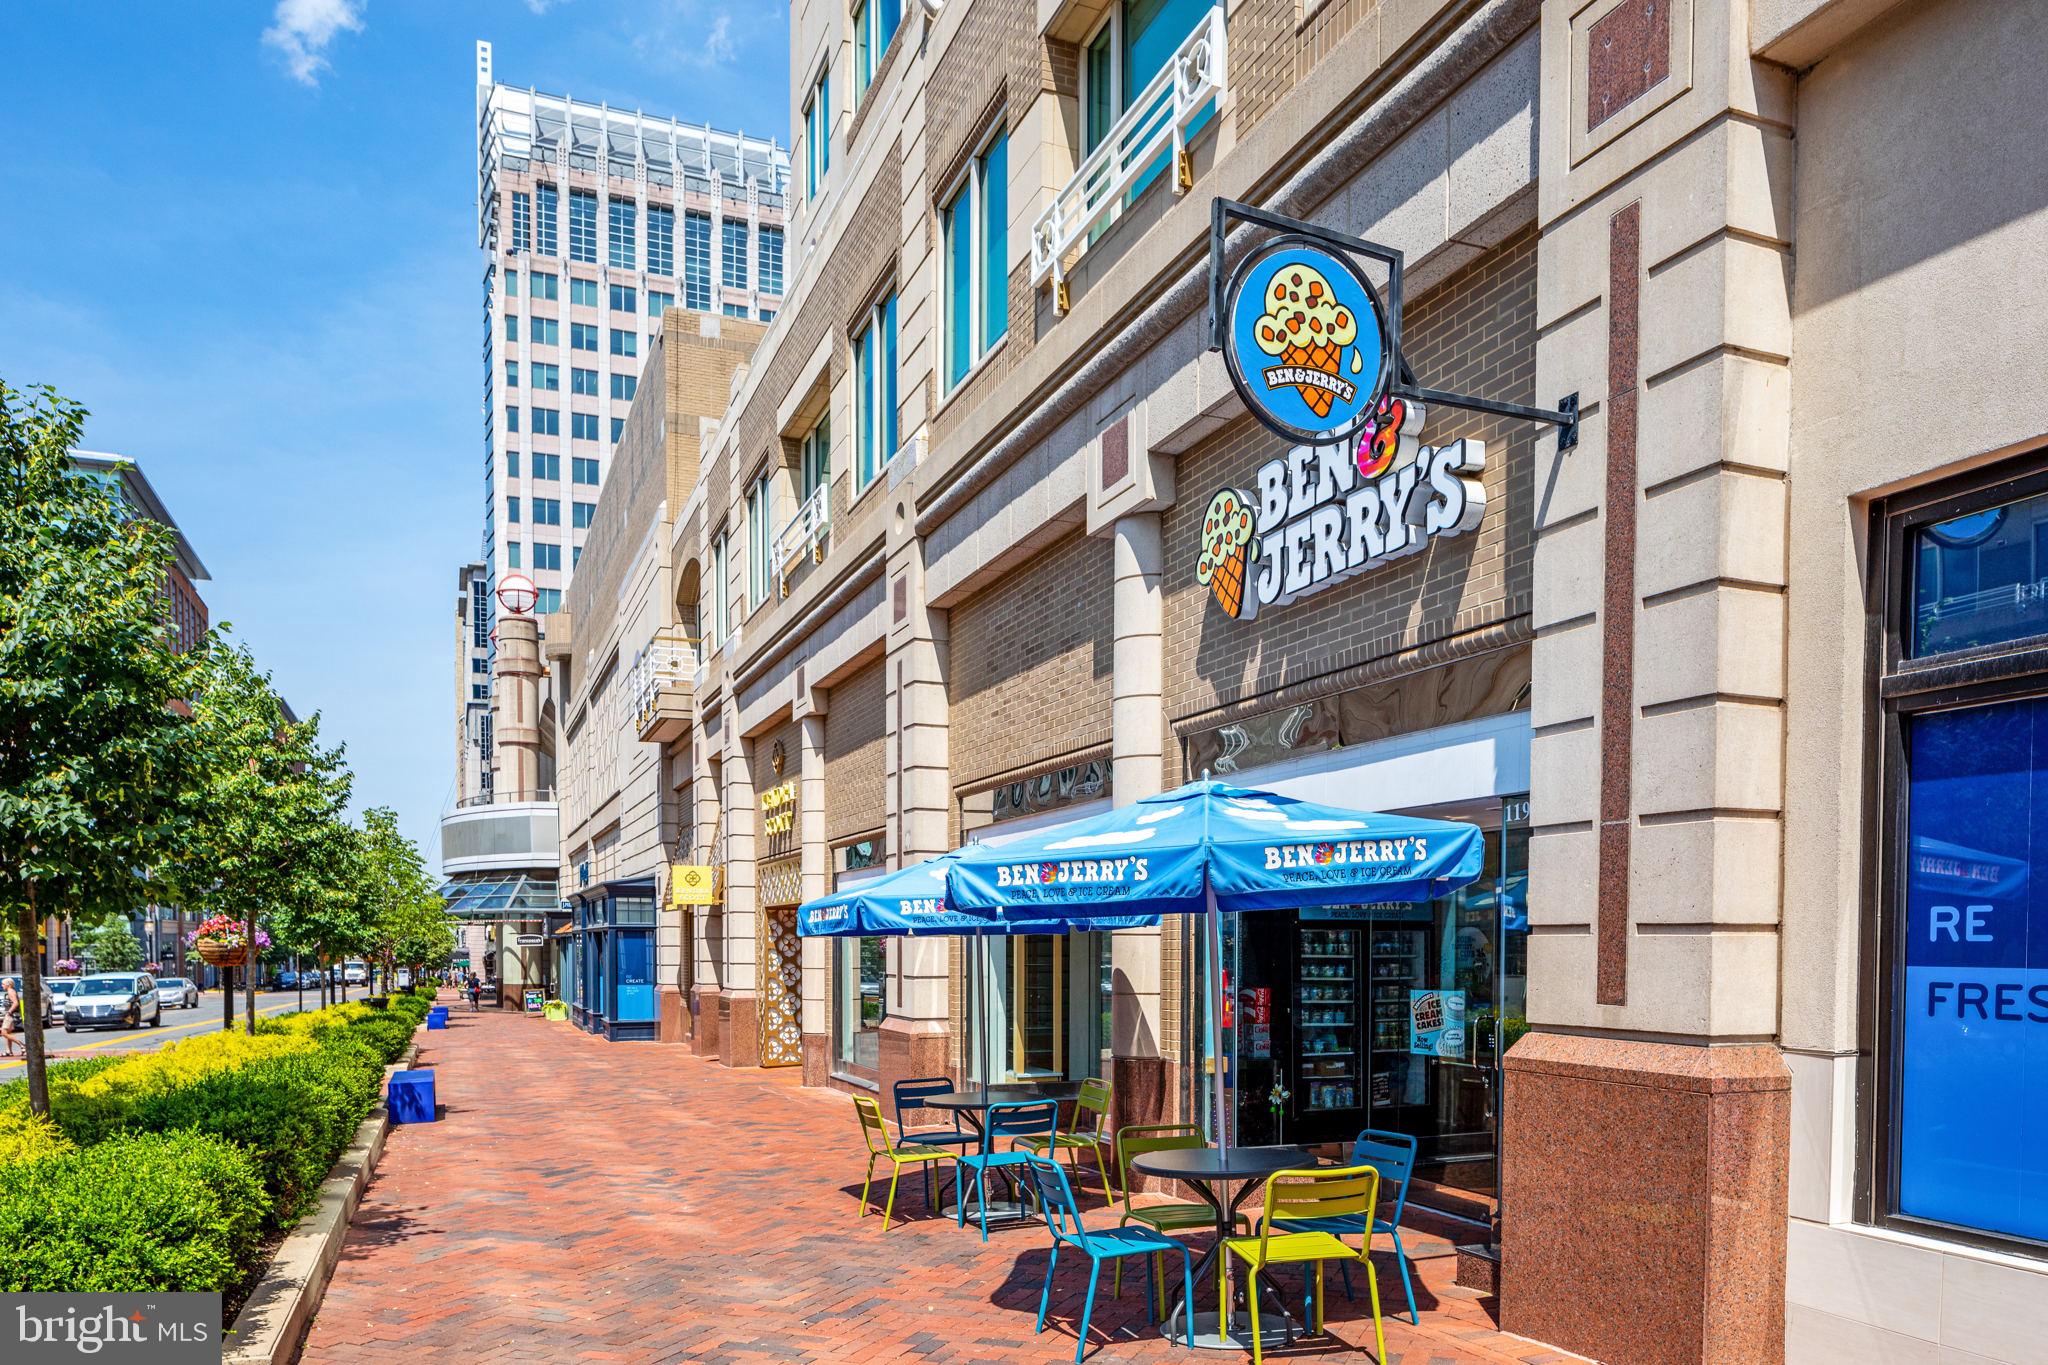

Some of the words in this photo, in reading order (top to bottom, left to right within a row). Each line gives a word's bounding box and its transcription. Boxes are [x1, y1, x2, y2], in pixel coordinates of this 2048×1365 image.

[1257, 430, 1357, 534] BEN
[1257, 438, 1468, 604] JERRY'S
[1264, 844, 1315, 870] BEN
[1334, 836, 1428, 864] JERRY'S
[997, 863, 1040, 887] BEN
[1058, 856, 1148, 882] JERRY'S
[1320, 868, 1346, 880] LOVE
[1361, 867, 1376, 878] ICE
[1380, 865, 1412, 876] CREAM
[1043, 887, 1066, 898] LOVE
[1078, 886, 1093, 897] ICE
[1095, 886, 1131, 897] CREAM
[900, 898, 936, 915] BEN
[940, 915, 958, 923] LOVE
[1929, 904, 1994, 943] RE
[1427, 998, 1441, 1010] ICE
[1414, 1008, 1443, 1022] CREAM
[1416, 1018, 1445, 1030] CAKES!
